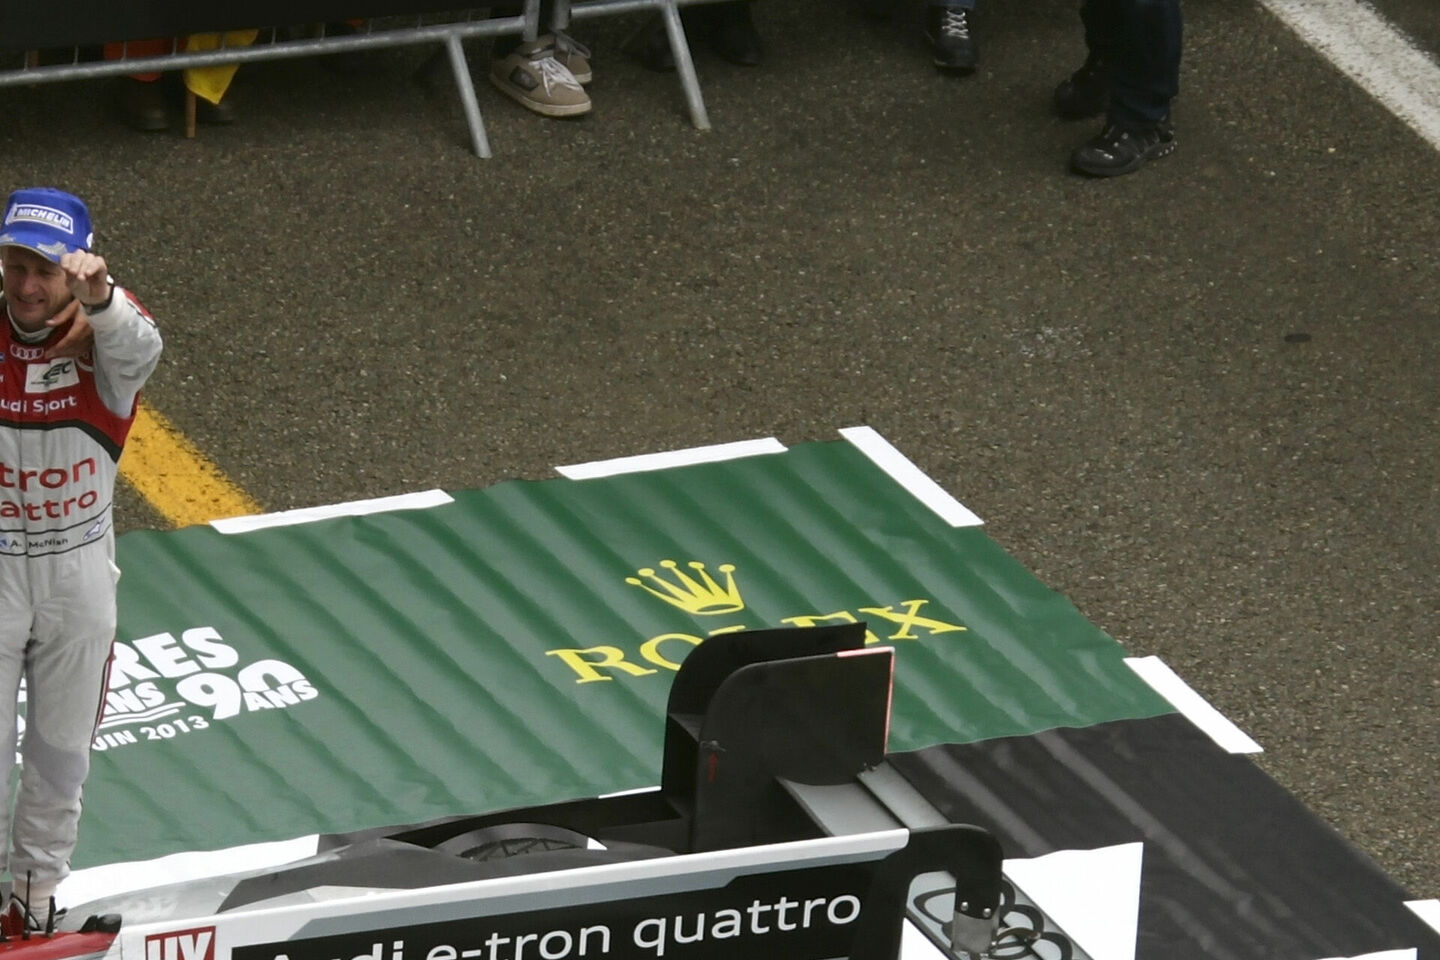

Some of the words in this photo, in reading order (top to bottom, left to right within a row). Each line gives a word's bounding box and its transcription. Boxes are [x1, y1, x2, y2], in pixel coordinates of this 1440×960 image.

[17, 210, 70, 228] MICHELIN
[33, 395, 77, 415] Sport
[10, 540, 22, 548] A.
[28, 537, 69, 549] McNish
[545, 599, 968, 684] ROX
[176, 659, 307, 720] 90
[242, 680, 319, 713] ANS
[140, 716, 210, 741] 2013
[632, 892, 862, 957] quattro
